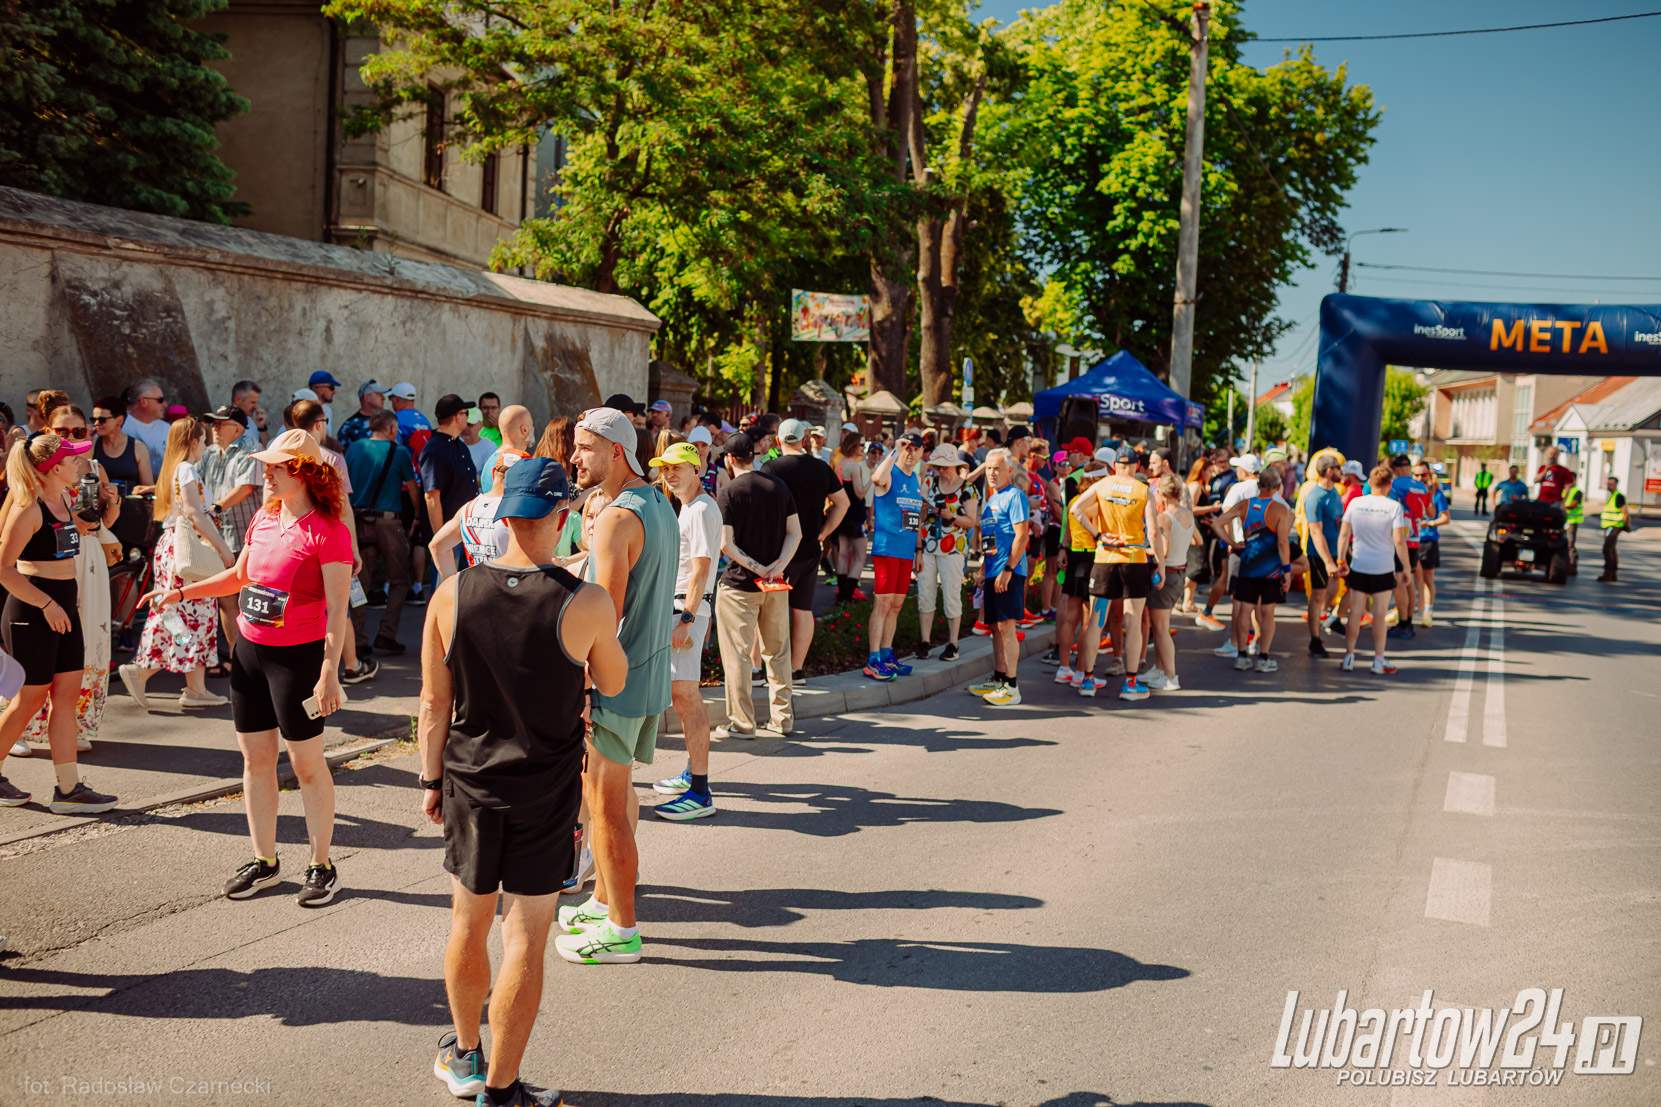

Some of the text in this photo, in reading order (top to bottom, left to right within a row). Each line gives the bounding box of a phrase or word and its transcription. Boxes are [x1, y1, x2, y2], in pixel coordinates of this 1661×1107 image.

[1413, 323, 1465, 337] inesSport
[1489, 318, 1609, 354] META
[246, 596, 270, 614] 131
